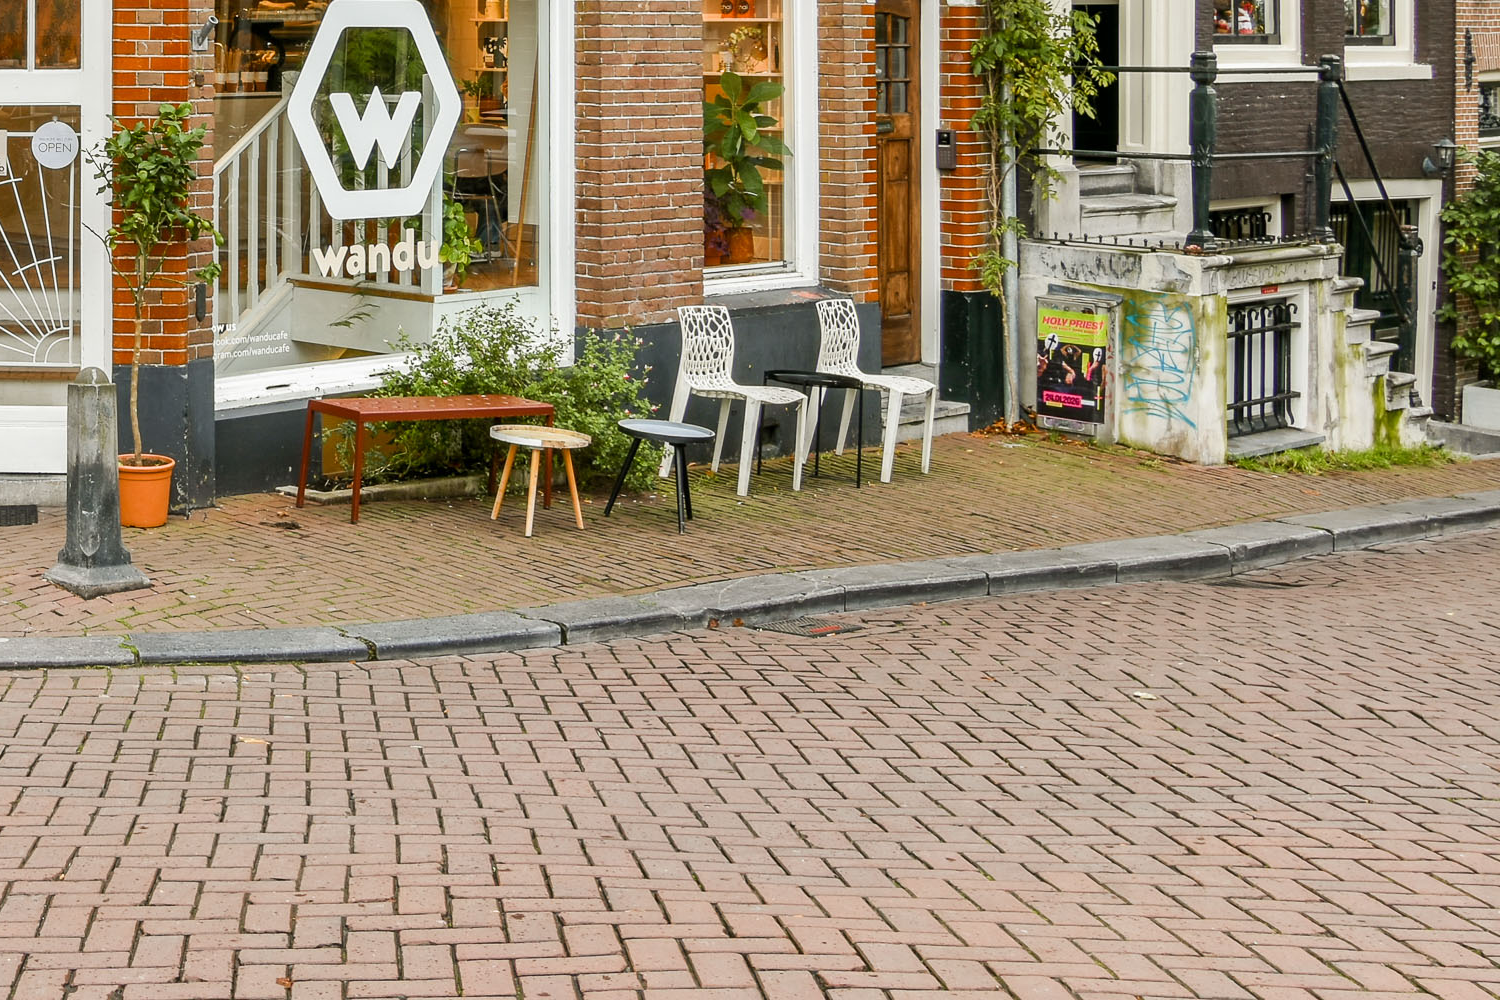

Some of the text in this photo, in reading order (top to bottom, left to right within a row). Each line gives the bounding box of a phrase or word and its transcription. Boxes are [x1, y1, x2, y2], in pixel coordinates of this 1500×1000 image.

[38, 142, 72, 153] OPEN
[329, 85, 422, 171] W
[312, 228, 439, 278] wandu
